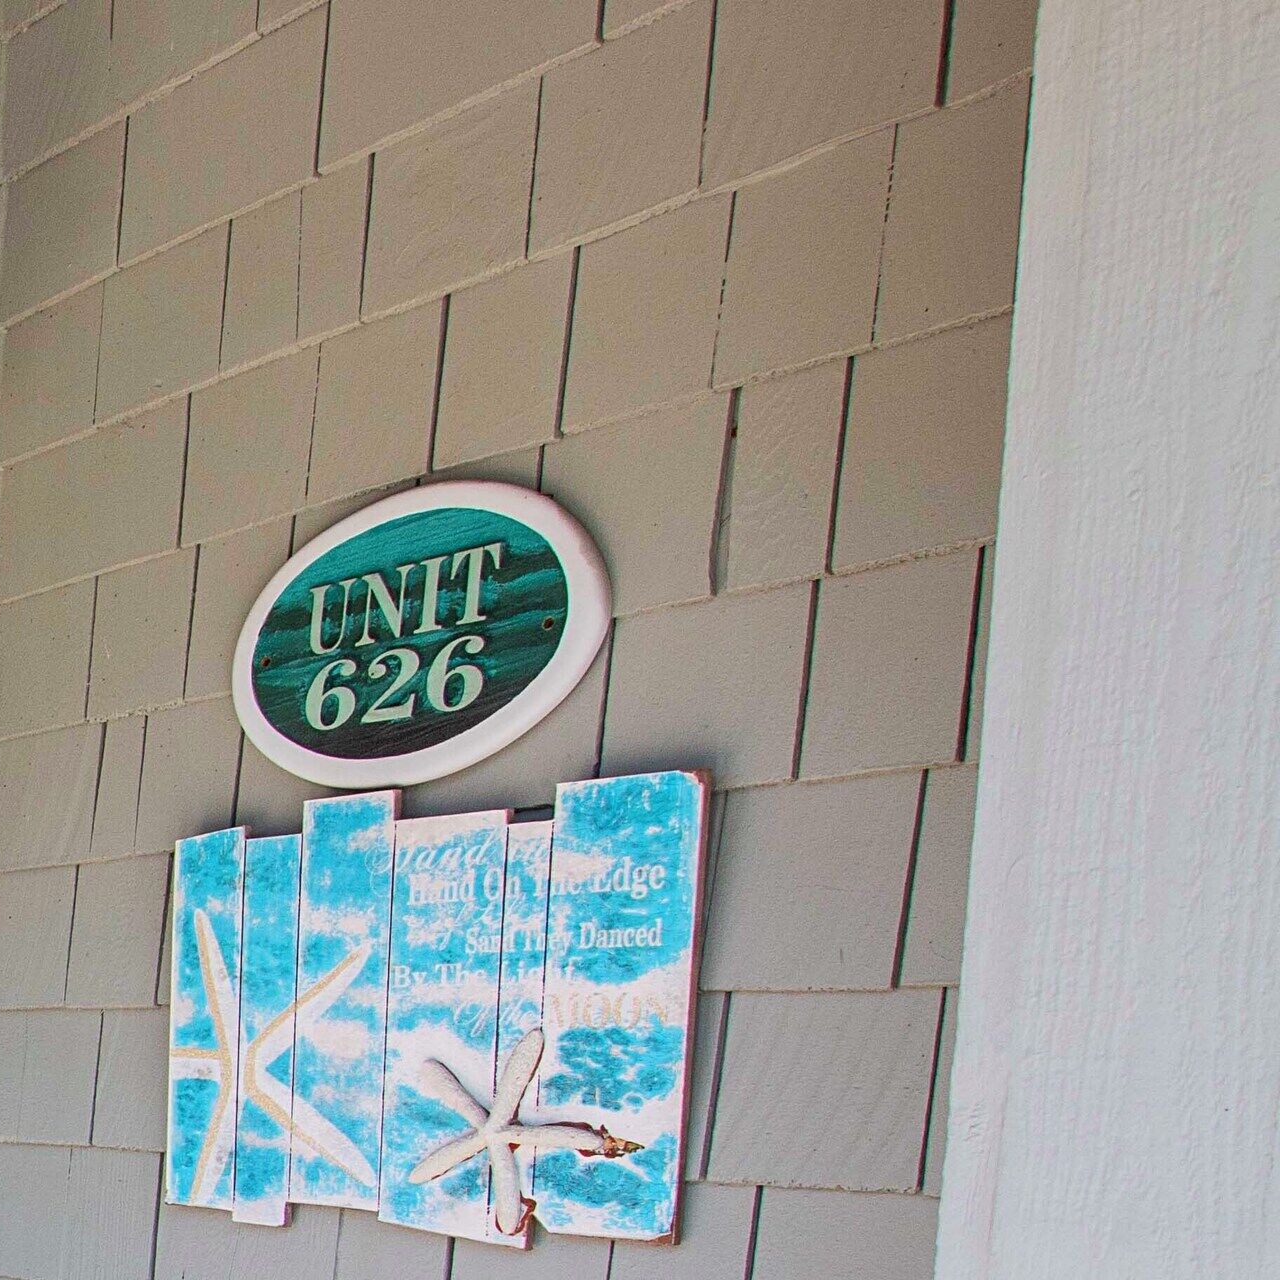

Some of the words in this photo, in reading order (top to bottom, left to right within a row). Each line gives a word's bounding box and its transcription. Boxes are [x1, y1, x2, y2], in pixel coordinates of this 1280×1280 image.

[308, 542, 503, 656] UNIT
[304, 634, 486, 732] 626
[483, 866, 522, 902] On
[590, 856, 666, 900] Edge
[578, 918, 663, 950] Danced
[434, 960, 488, 987] The
